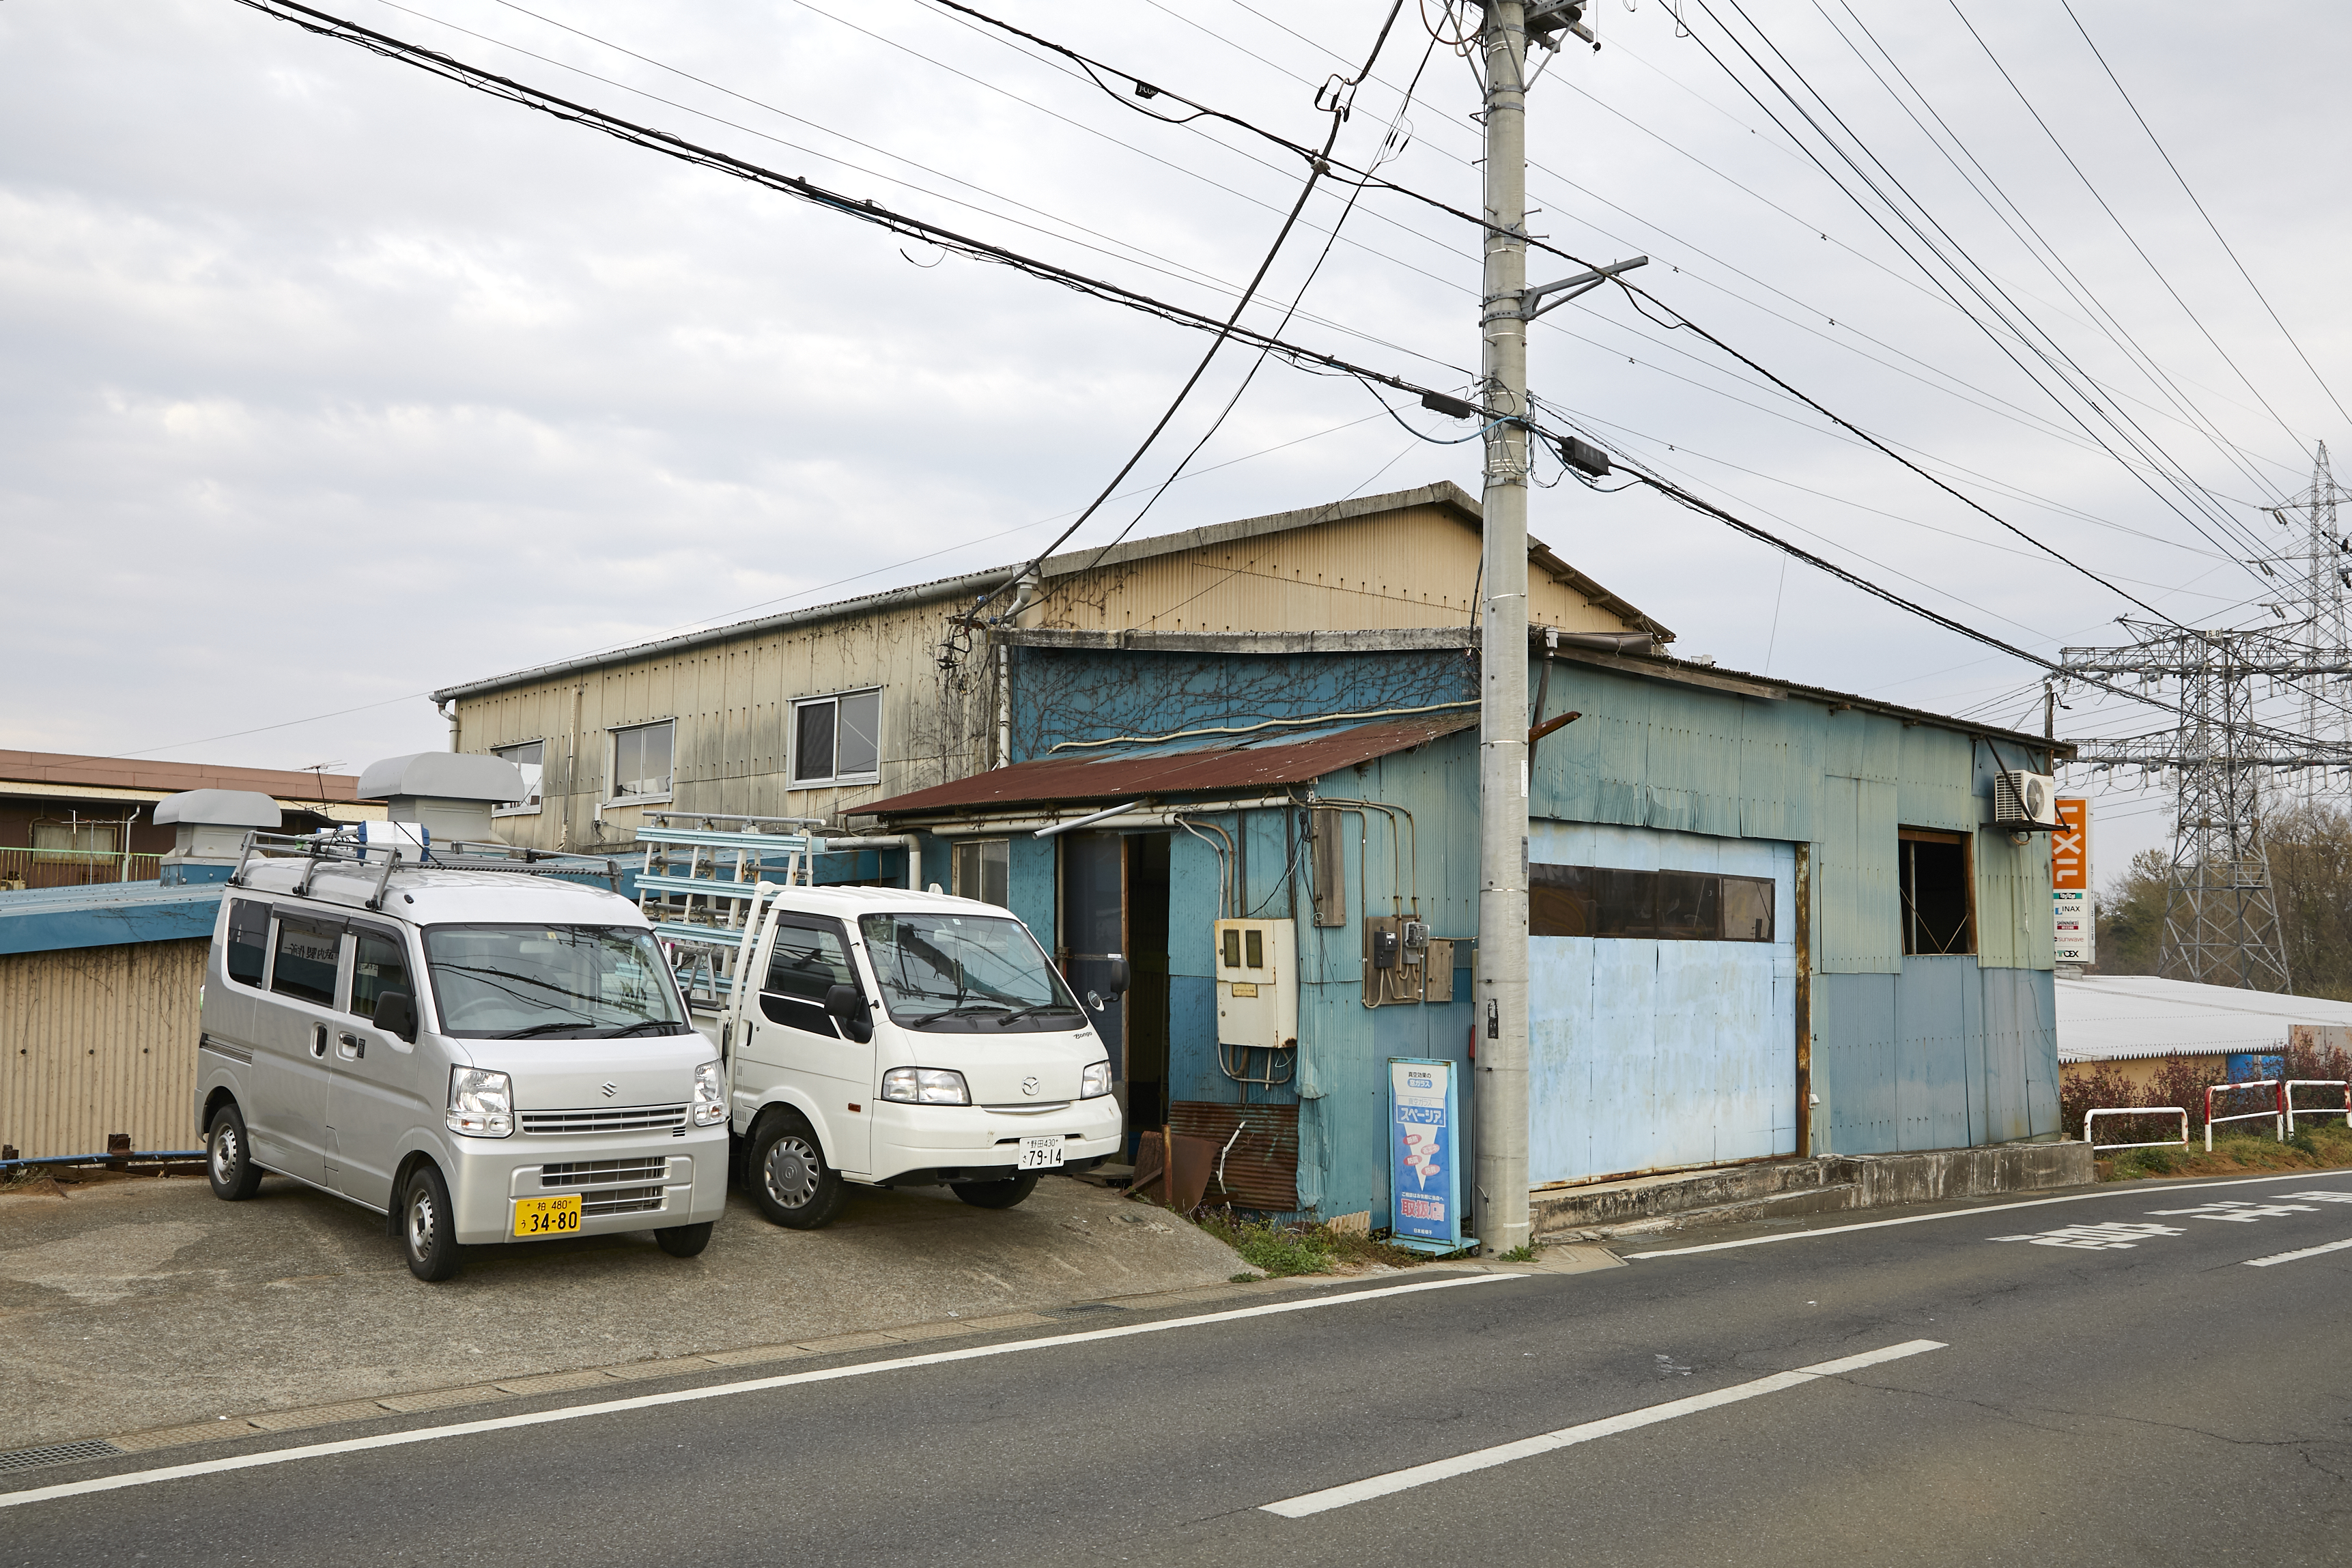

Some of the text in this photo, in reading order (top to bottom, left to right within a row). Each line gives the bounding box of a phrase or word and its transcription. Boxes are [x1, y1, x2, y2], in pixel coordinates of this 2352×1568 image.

[2056, 950, 2079, 958] TOEX
[1073, 1031, 1092, 1039] Bongo
[1409, 1079, 1430, 1087] 窓ガラス
[1408, 1098, 1432, 1107] 真空ガラス
[1030, 1139, 1055, 1148] 野田 430
[1422, 1145, 1438, 1154] 省エネ
[1022, 1148, 1062, 1166] さ 79-14
[1424, 1166, 1436, 1175] 防音
[537, 1200, 567, 1211] 柏 480
[1401, 1198, 1445, 1222] 取扱店
[521, 1211, 577, 1232] う 34-80
